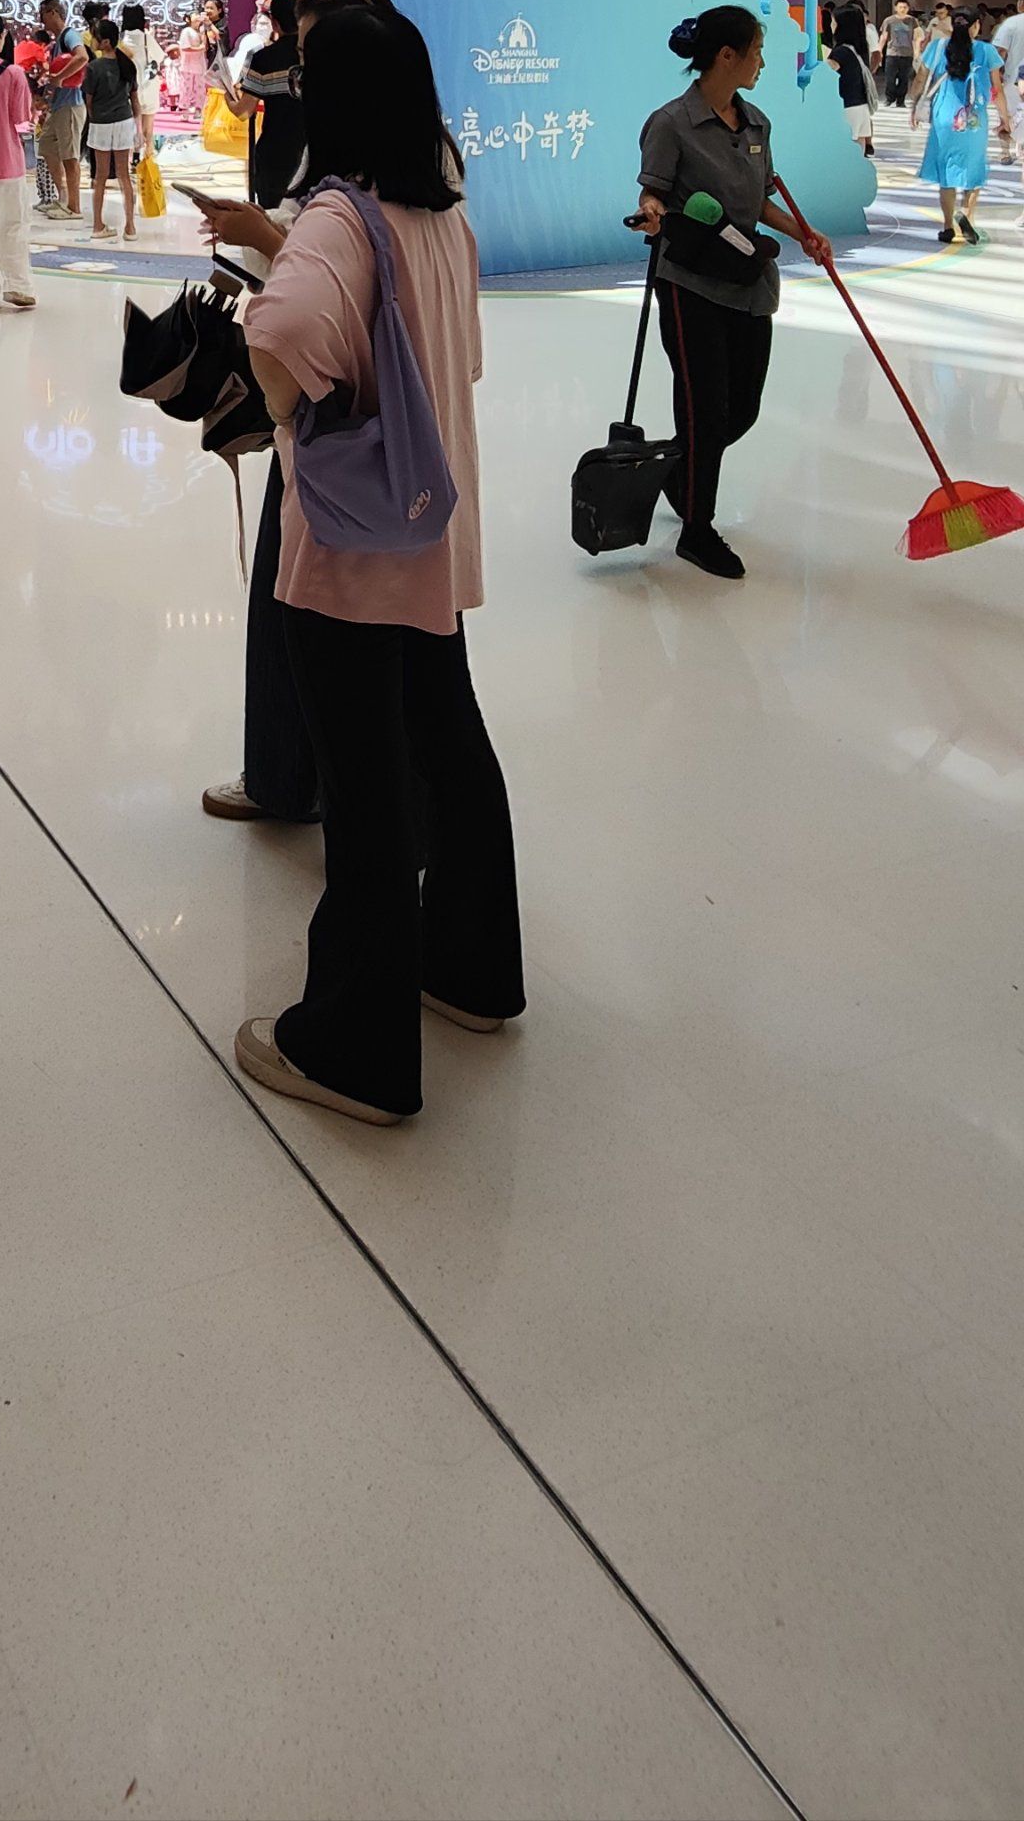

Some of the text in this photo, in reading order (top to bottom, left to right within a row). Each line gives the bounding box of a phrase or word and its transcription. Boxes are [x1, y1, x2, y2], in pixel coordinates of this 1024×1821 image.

[525, 57, 560, 69] RESORT
[443, 106, 595, 162] 亮心中奇梦
